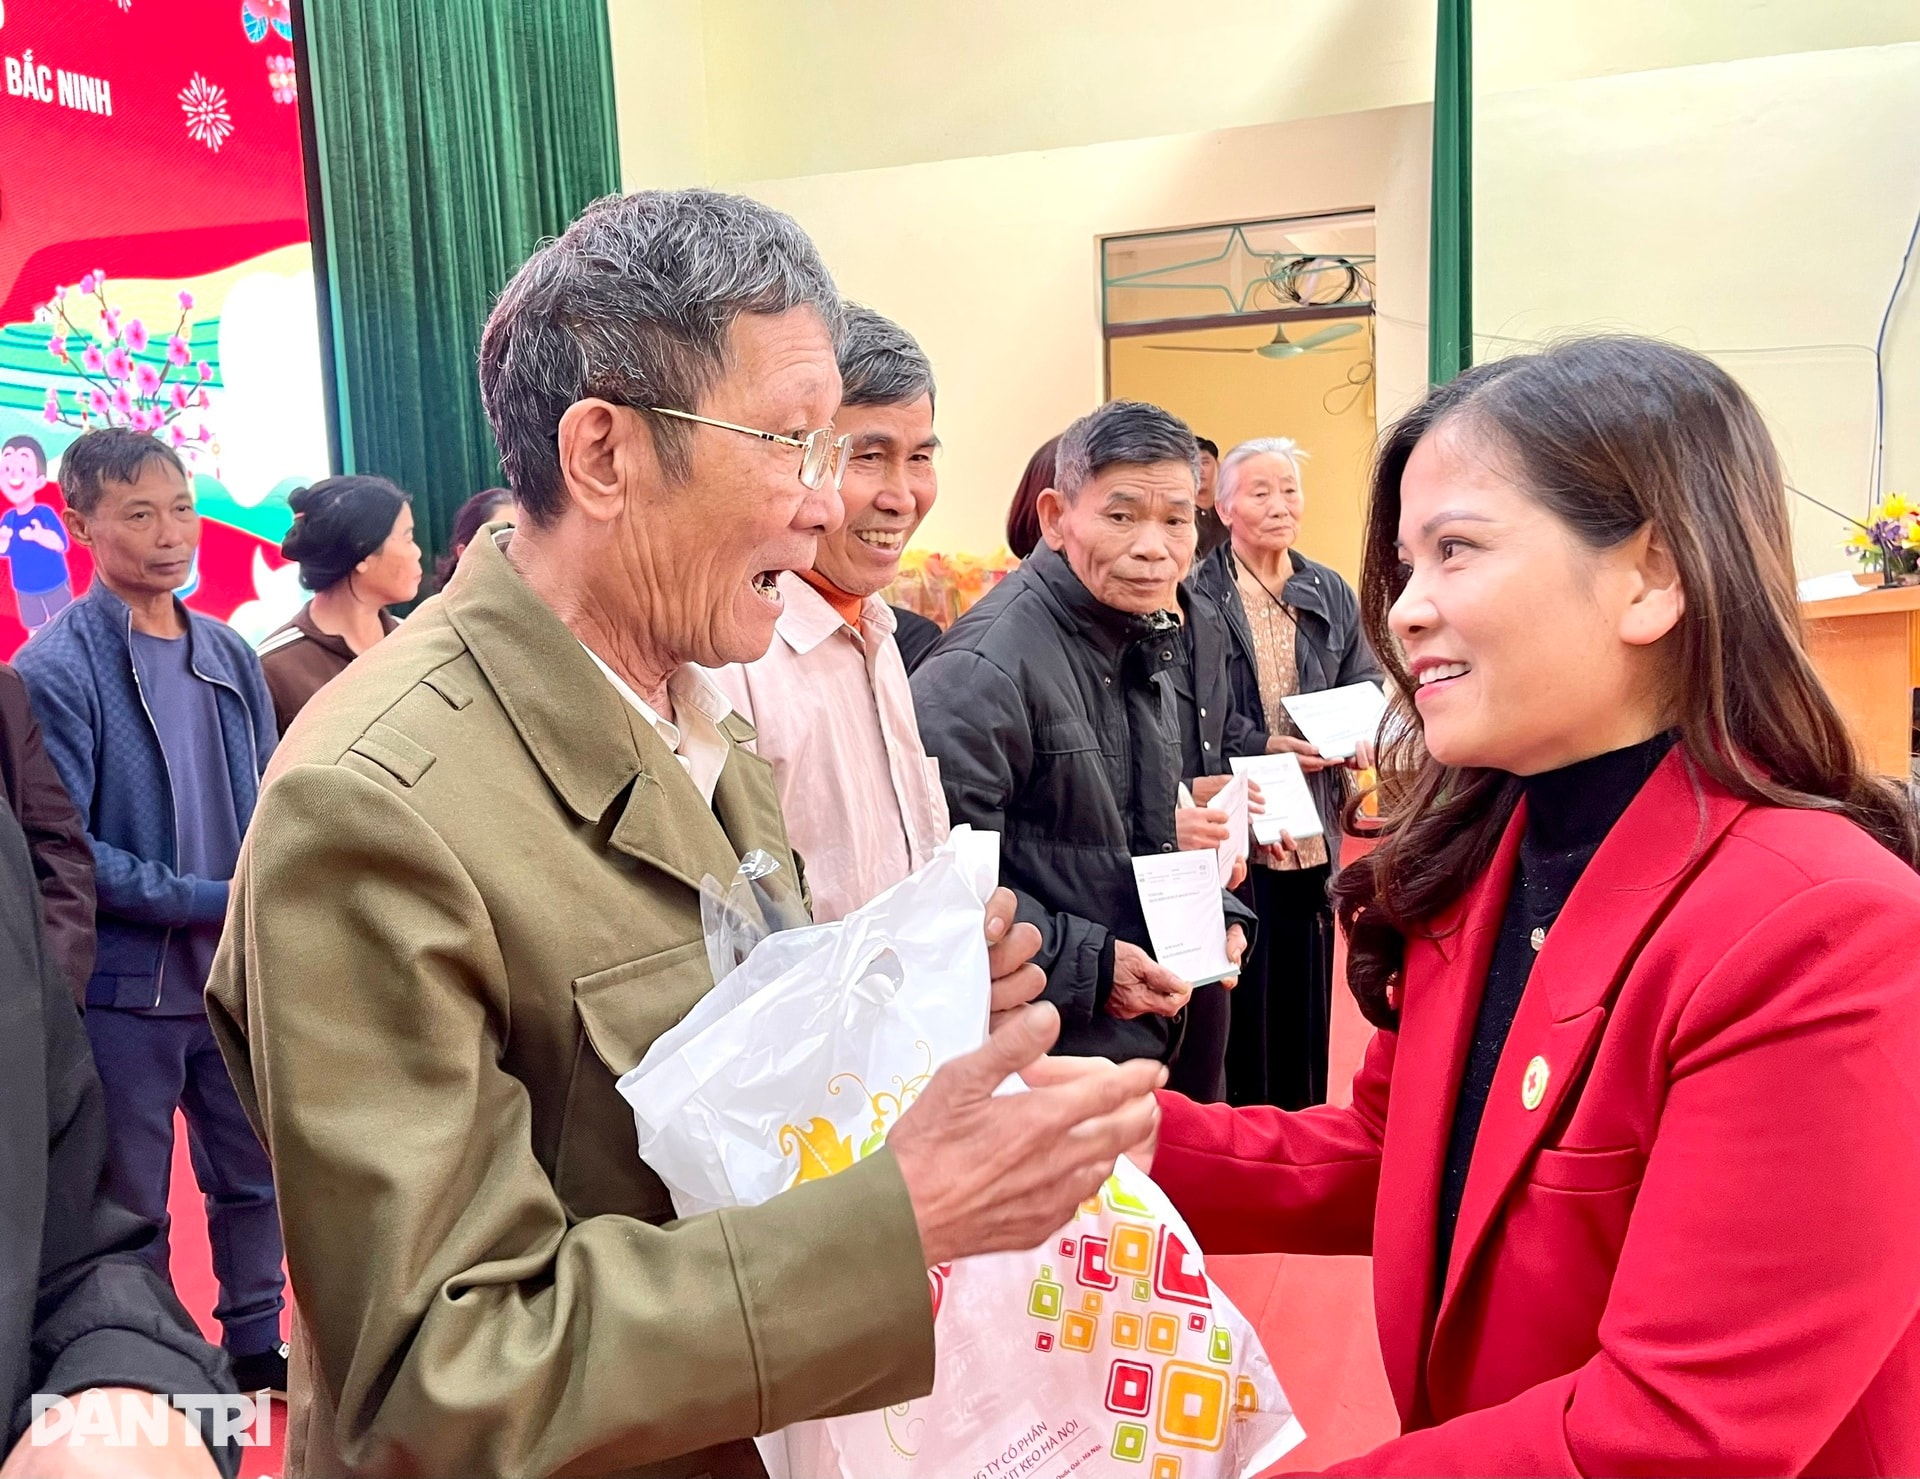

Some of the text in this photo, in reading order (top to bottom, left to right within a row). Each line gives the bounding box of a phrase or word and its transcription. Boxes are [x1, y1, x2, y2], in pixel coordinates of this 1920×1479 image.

[5, 48, 113, 117] BẮC NINH
[984, 1458, 1001, 1475] TY
[1019, 1449, 1041, 1473] KẸO
[1040, 1434, 1059, 1455] HÀ
[1057, 1418, 1079, 1441] NỘI
